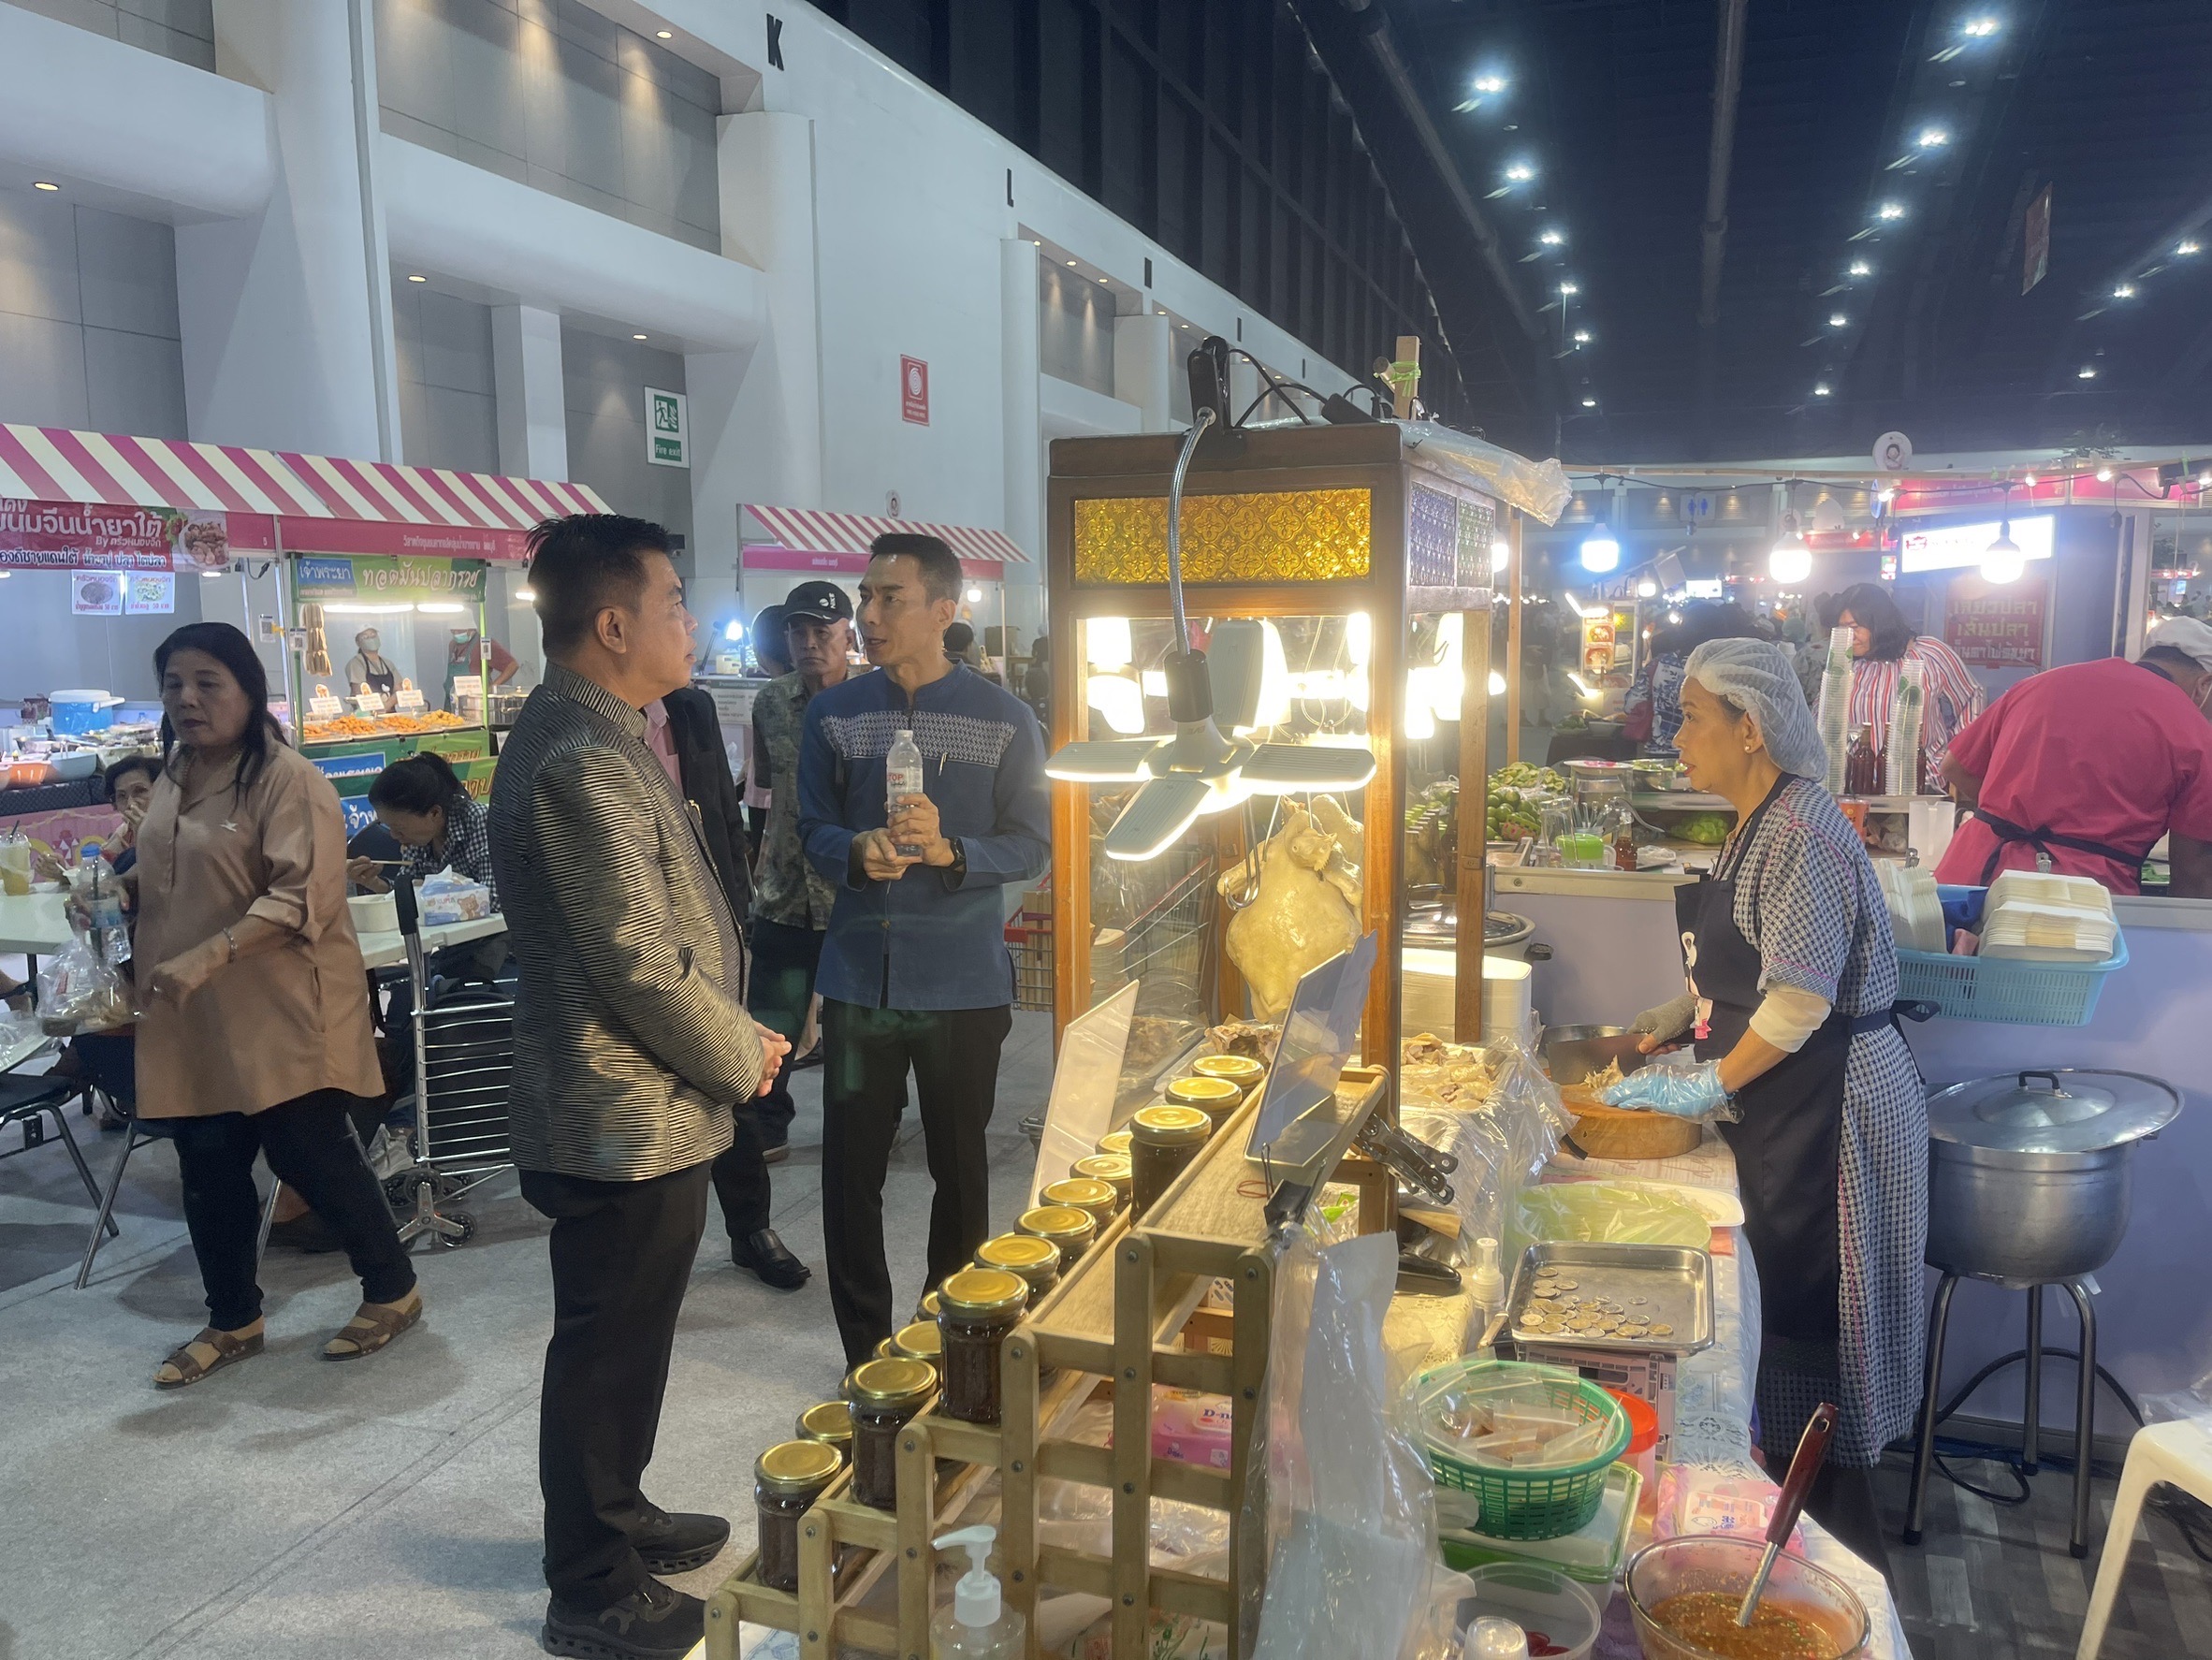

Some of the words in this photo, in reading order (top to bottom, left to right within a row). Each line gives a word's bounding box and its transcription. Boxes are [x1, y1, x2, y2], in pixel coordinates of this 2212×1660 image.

[766, 12, 784, 71] K
[656, 444, 667, 455] Fire
[669, 448, 681, 457] exit
[95, 536, 109, 547] By
[0, 546, 78, 564] องดีชายแดนใต้
[1203, 1409, 1231, 1419] D-n
